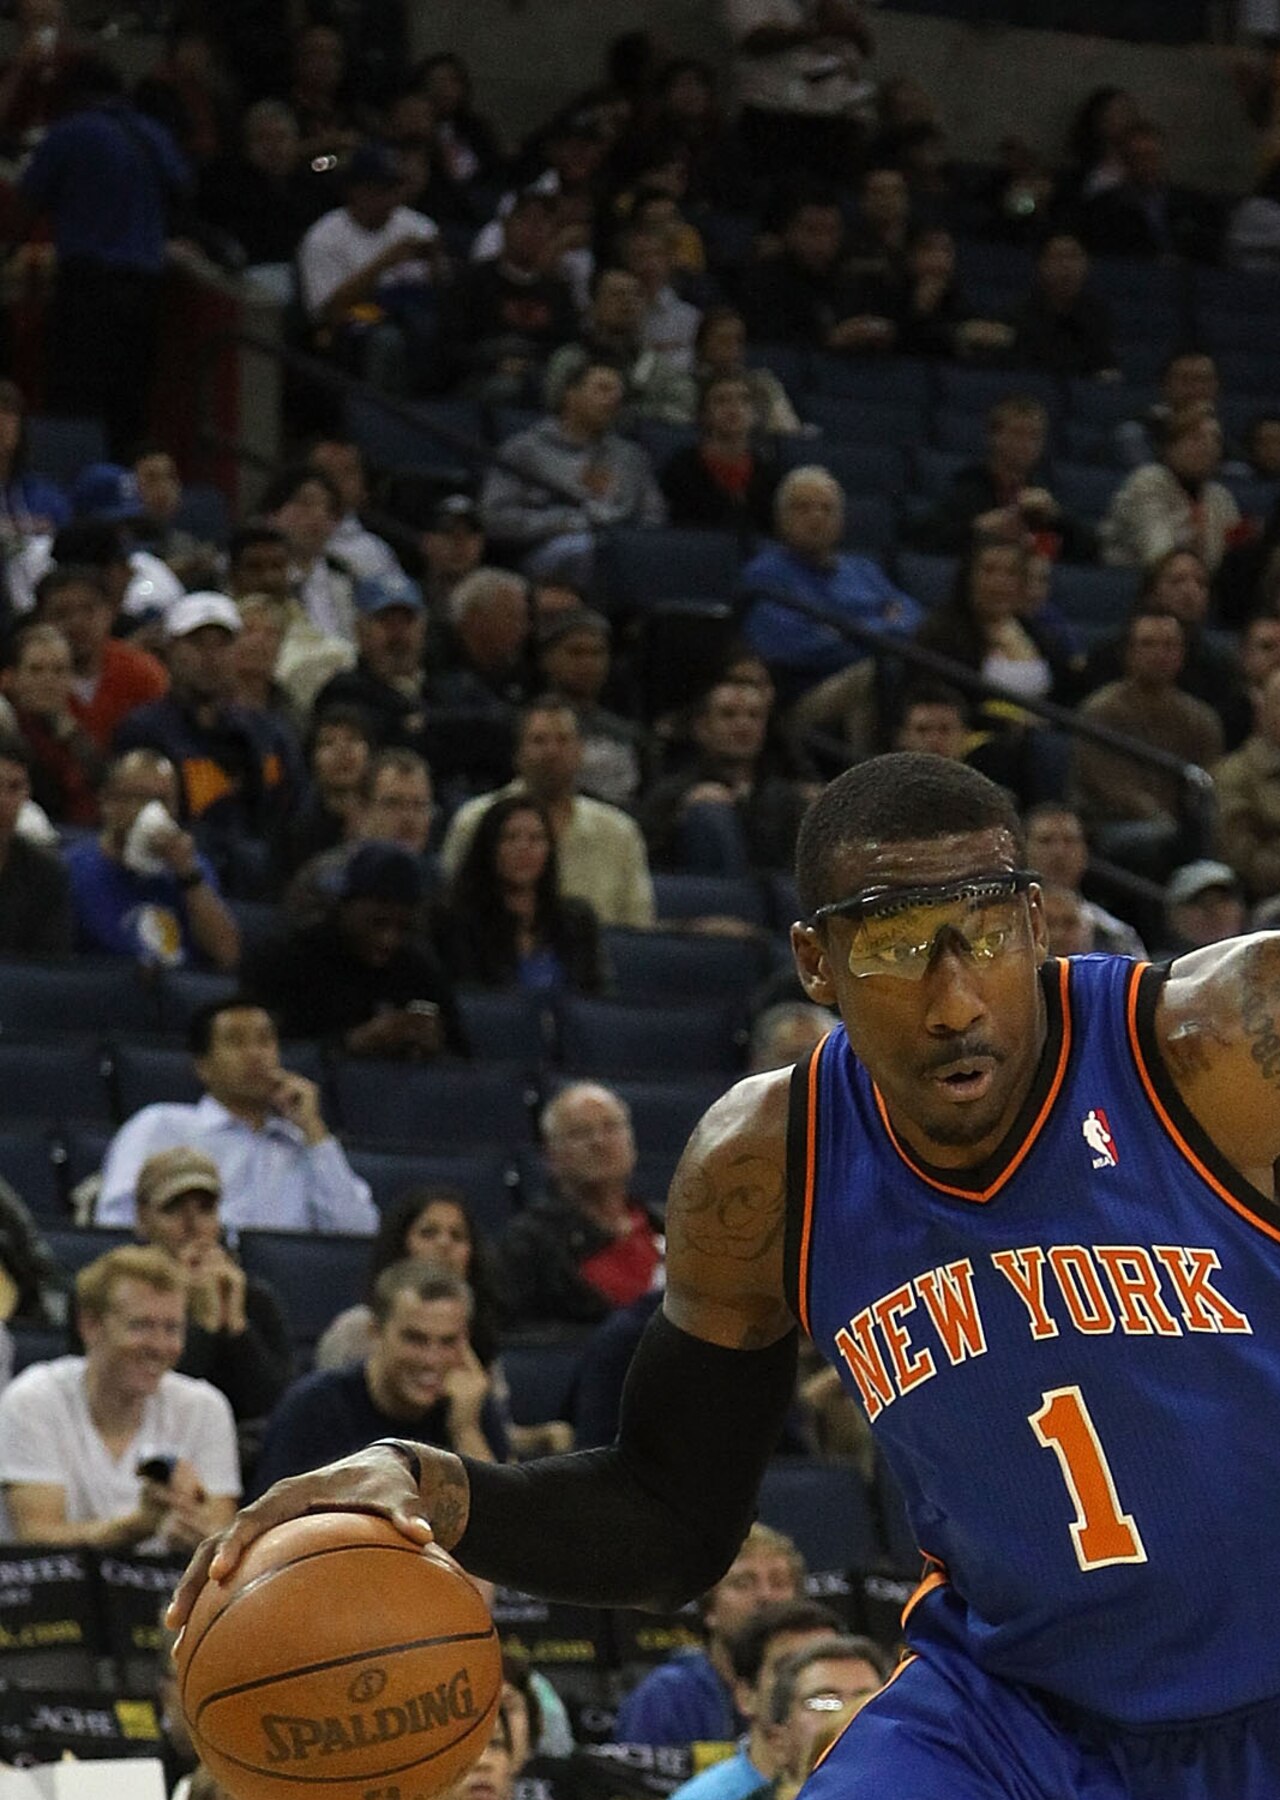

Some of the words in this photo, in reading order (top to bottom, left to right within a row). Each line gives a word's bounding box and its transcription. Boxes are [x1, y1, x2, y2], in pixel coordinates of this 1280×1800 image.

[834, 1257, 988, 1424] NEW
[991, 1244, 1254, 1342] YORK
[1027, 1385, 1149, 1573] 1
[261, 1667, 481, 1762] SPALDING
